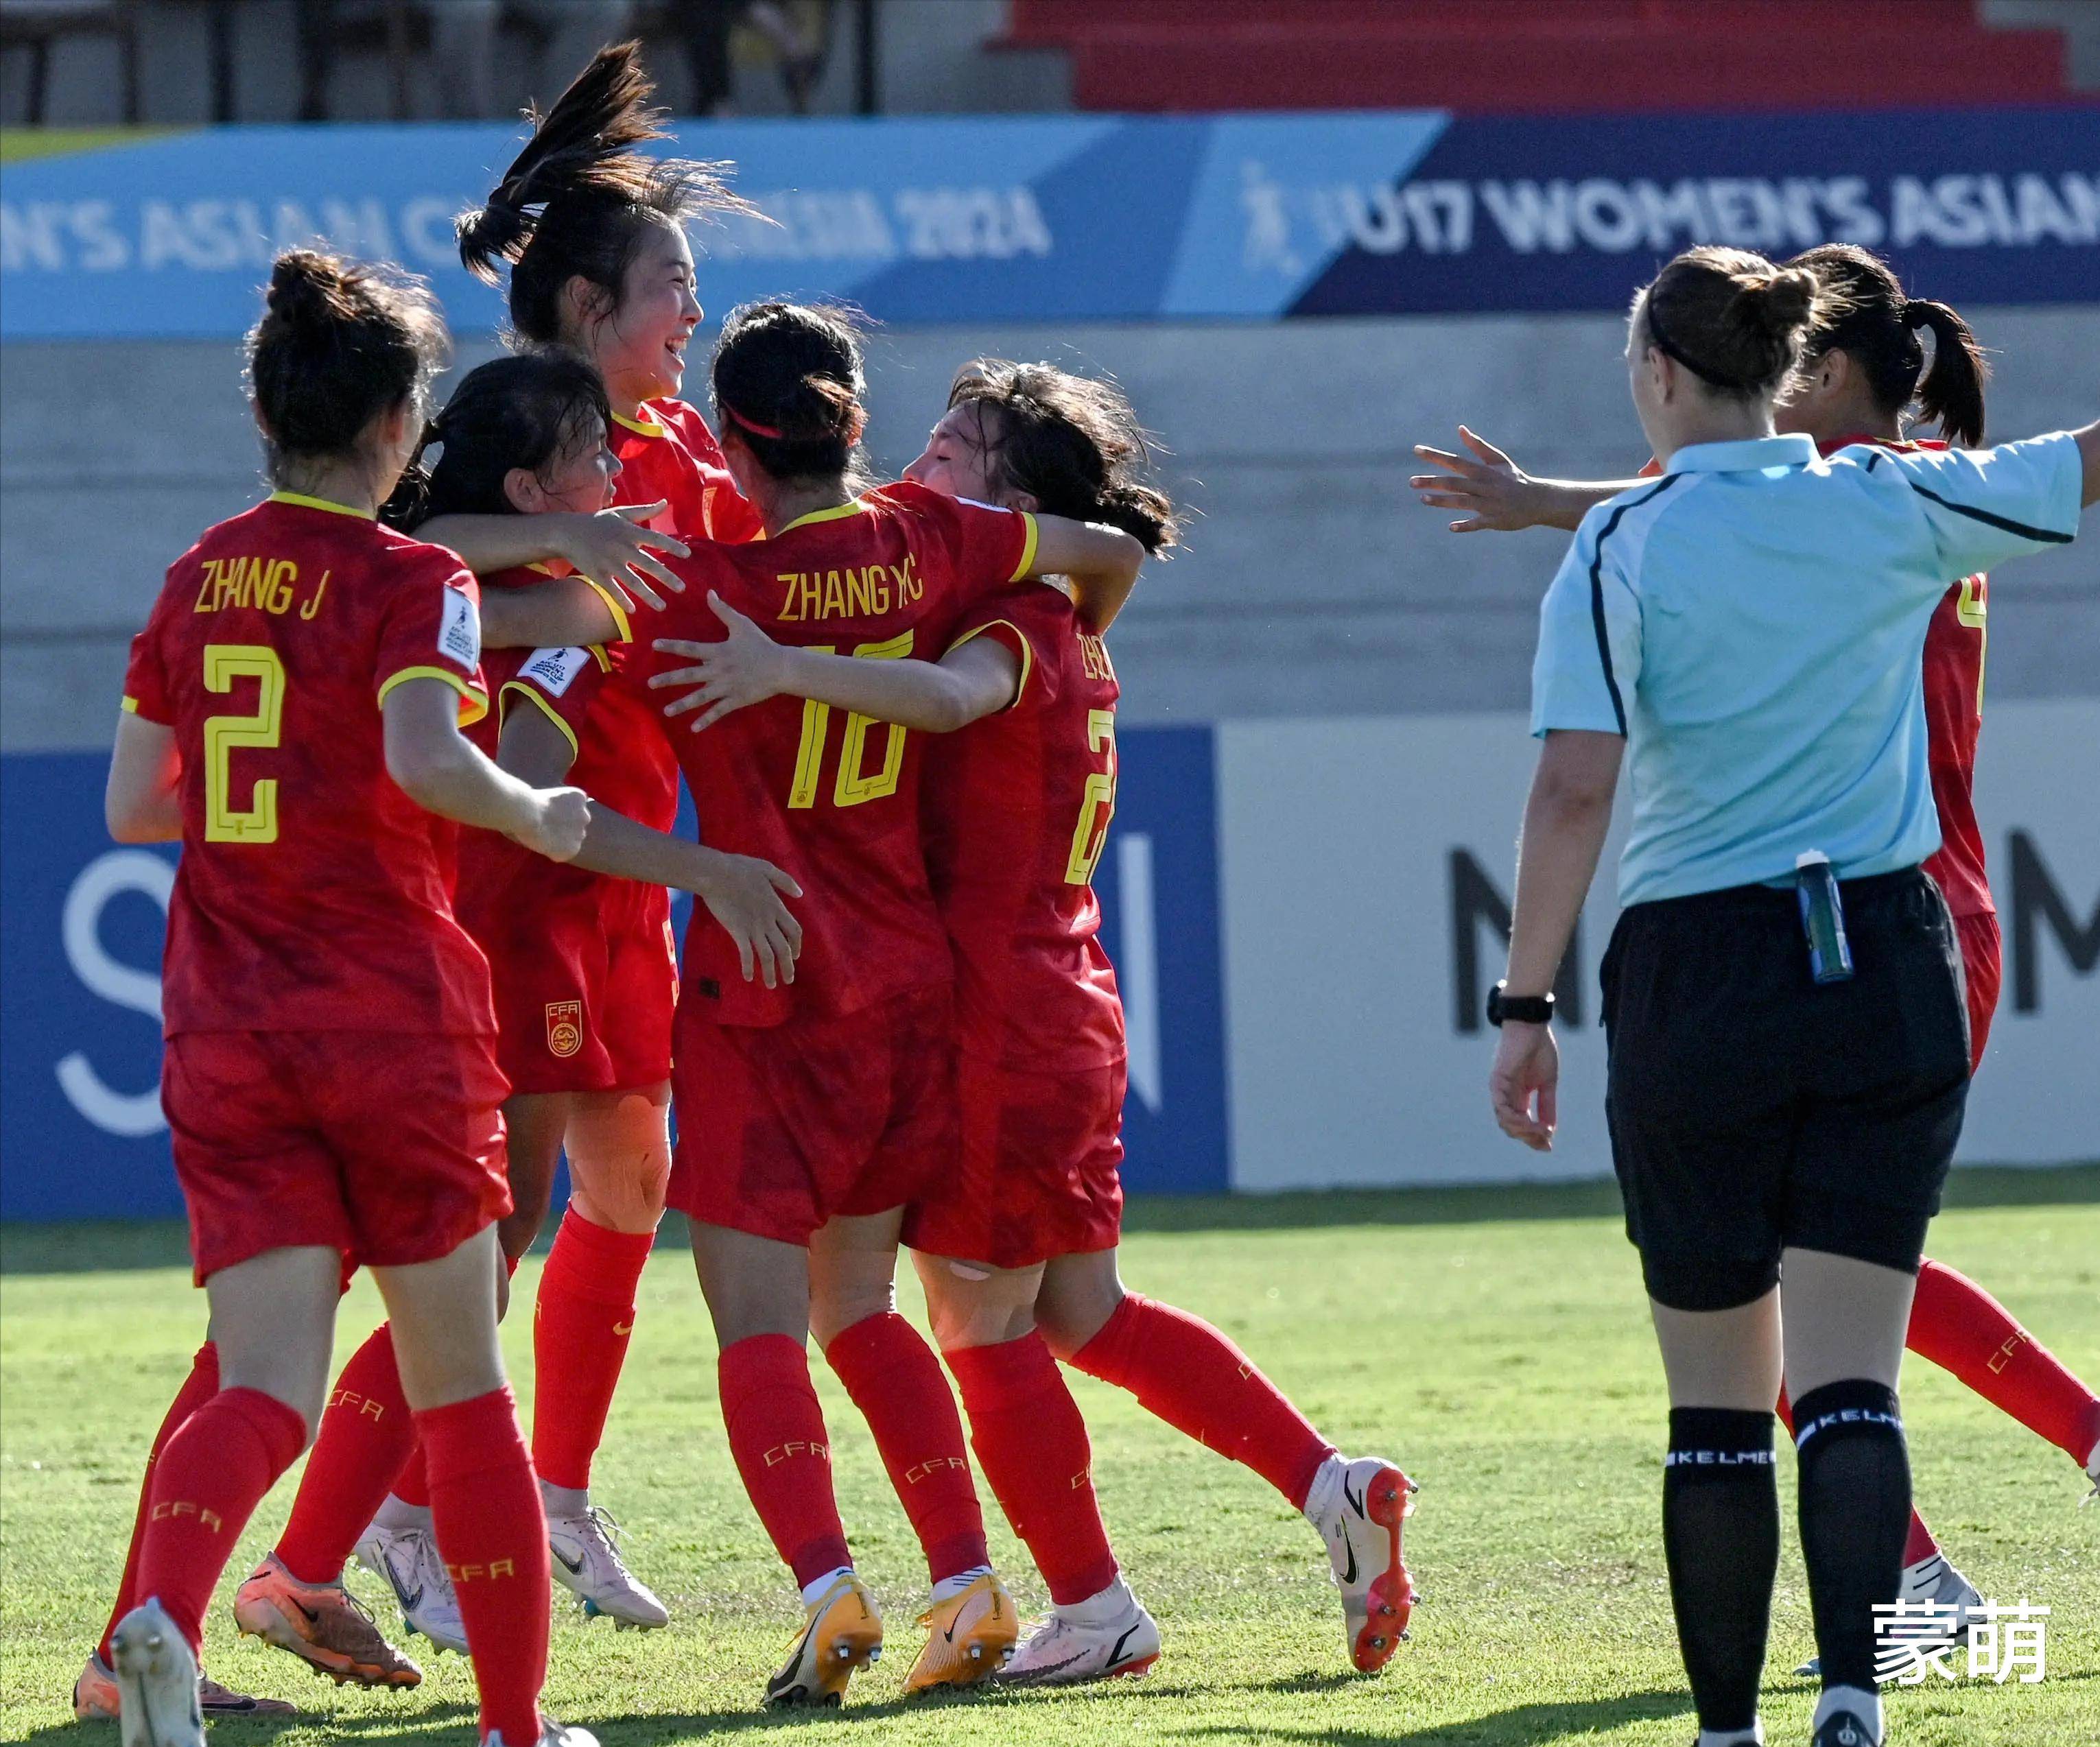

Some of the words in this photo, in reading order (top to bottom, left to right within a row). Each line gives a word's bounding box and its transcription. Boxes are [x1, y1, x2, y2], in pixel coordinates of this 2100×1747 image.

[1343, 176, 1474, 254] U17
[1478, 176, 1885, 254] WOMEN'S
[193, 556, 298, 615] ZHANG
[299, 569, 331, 621] J
[777, 564, 890, 621] ZHANG
[204, 644, 287, 843] 2
[549, 1004, 578, 1017] CFA
[326, 1389, 384, 1423] CFA
[763, 1441, 827, 1467] CFA
[905, 1457, 966, 1484] CFA
[1678, 1449, 1769, 1465] KELME
[152, 1500, 222, 1534] CFA
[445, 1557, 515, 1583] CFA
